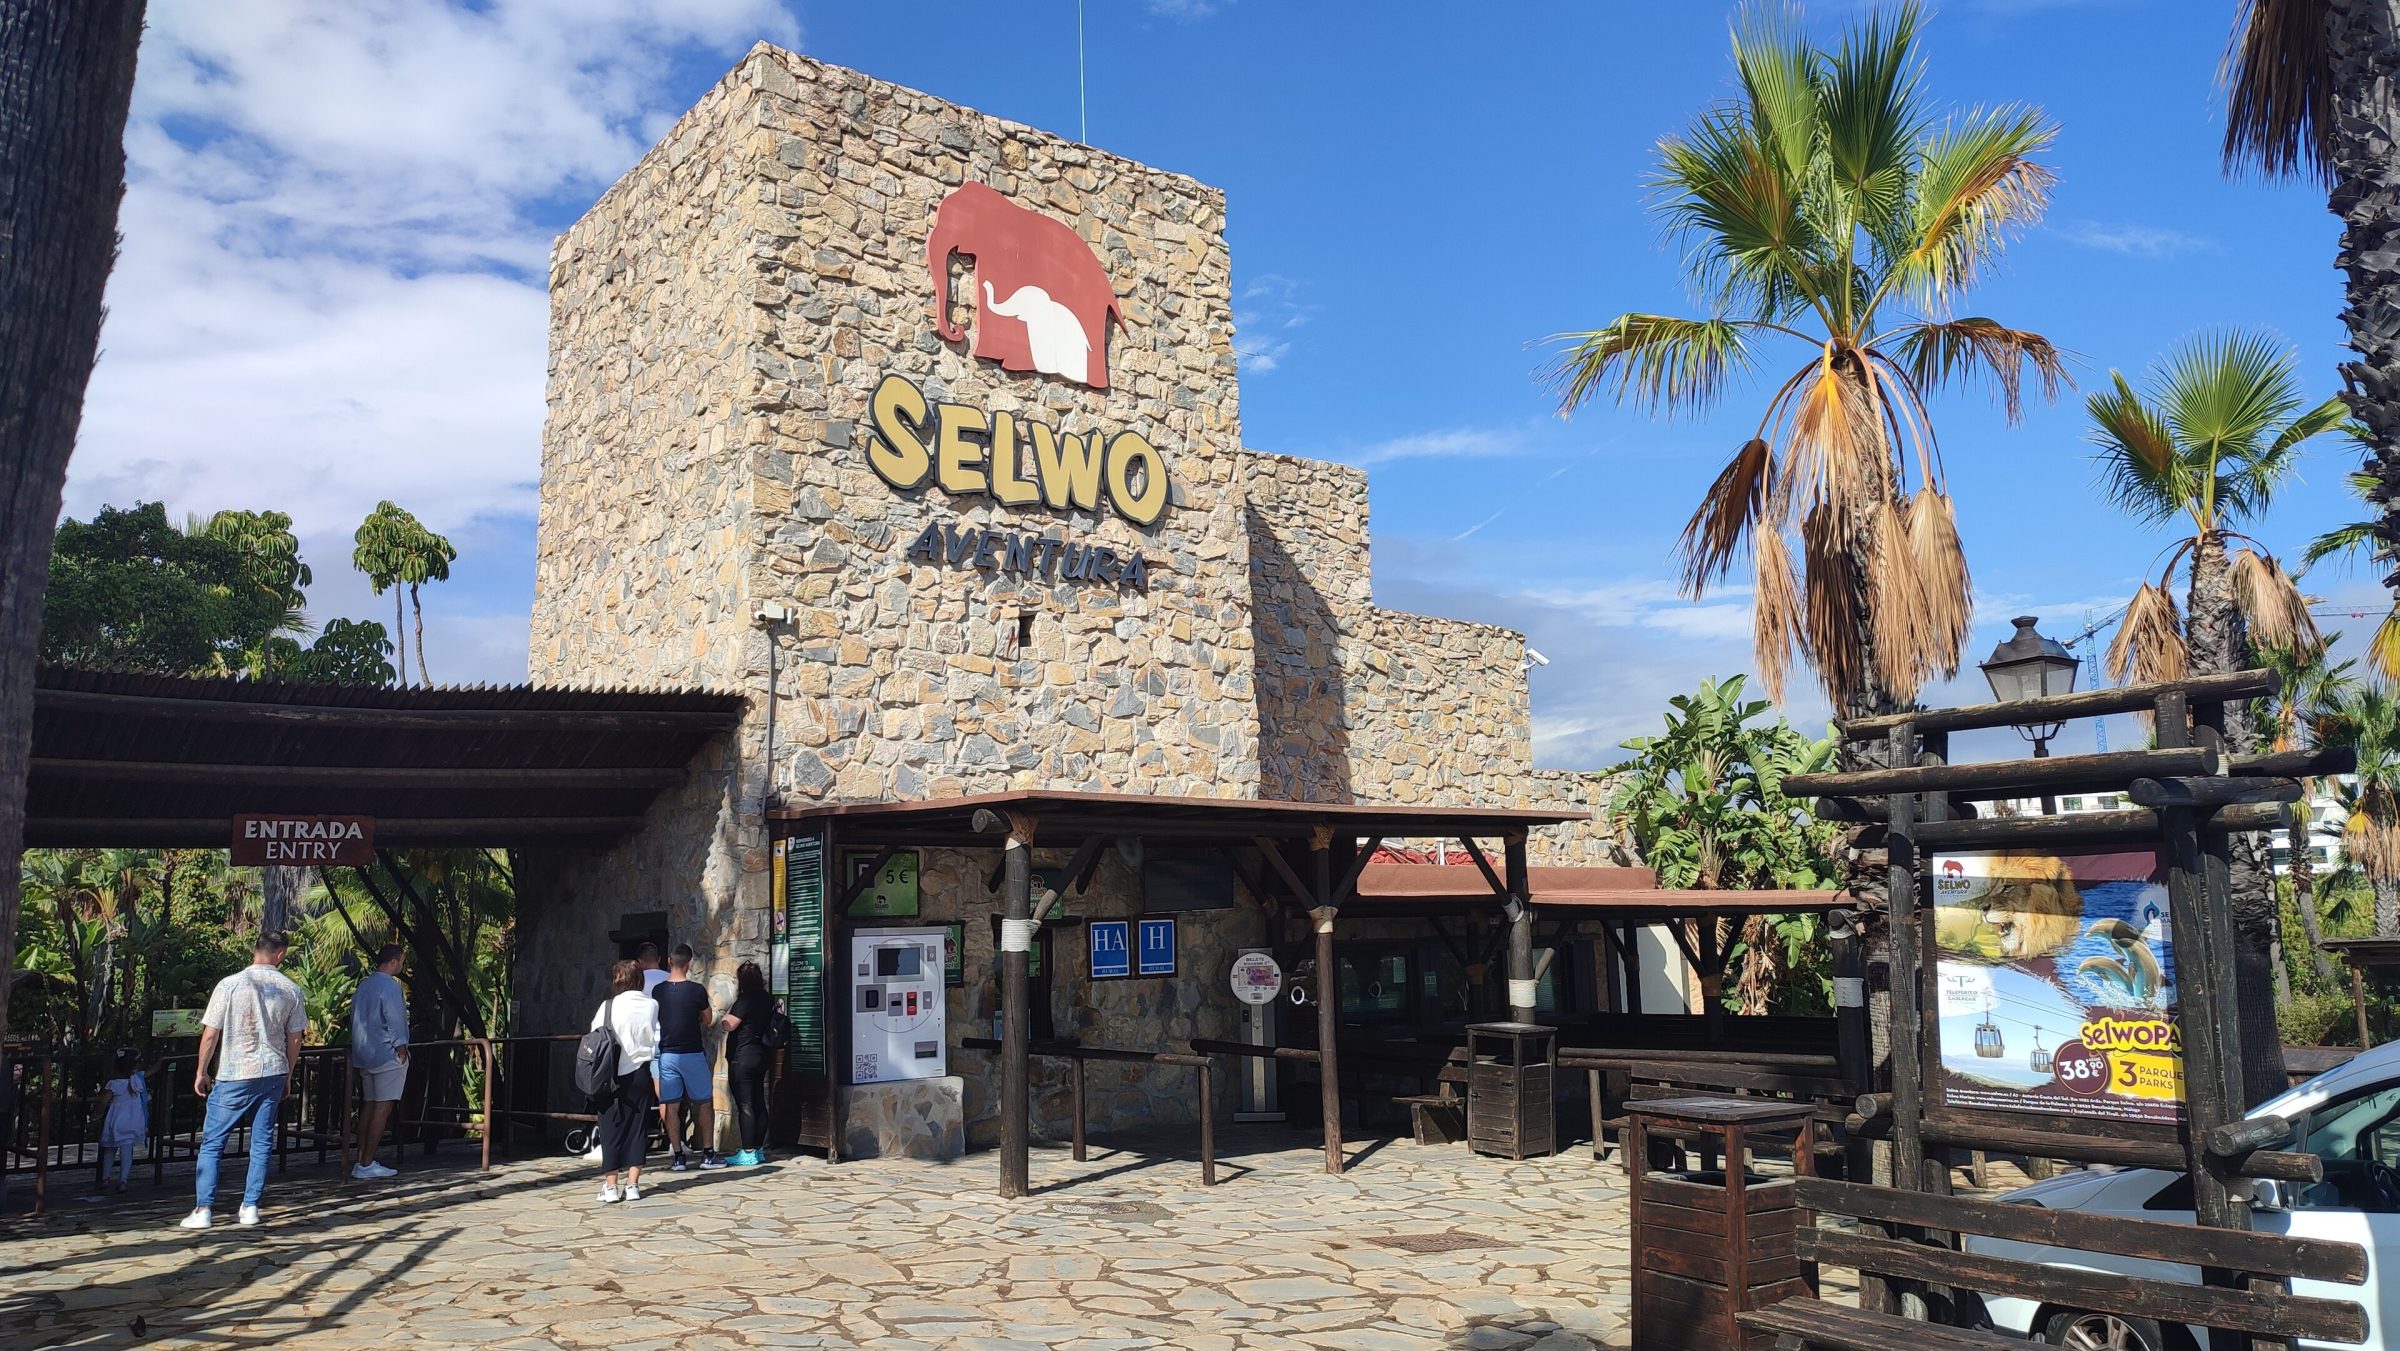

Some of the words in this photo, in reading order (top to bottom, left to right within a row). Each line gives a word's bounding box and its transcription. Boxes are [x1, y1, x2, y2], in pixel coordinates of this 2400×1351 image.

[866, 373, 1169, 526] SELWO
[907, 520, 1148, 590] AVENTURA
[244, 820, 364, 839] ENTRADA
[266, 841, 342, 859] ENTRY
[886, 869, 895, 884] 5
[899, 869, 909, 884] €
[1937, 878, 1971, 890] SELWO
[1092, 928, 1126, 952] HA
[1148, 925, 1166, 950] H
[2118, 1060, 2138, 1087] 3
[2139, 1066, 2184, 1081] PARQUE
[2139, 1077, 2174, 1090] PARKS
